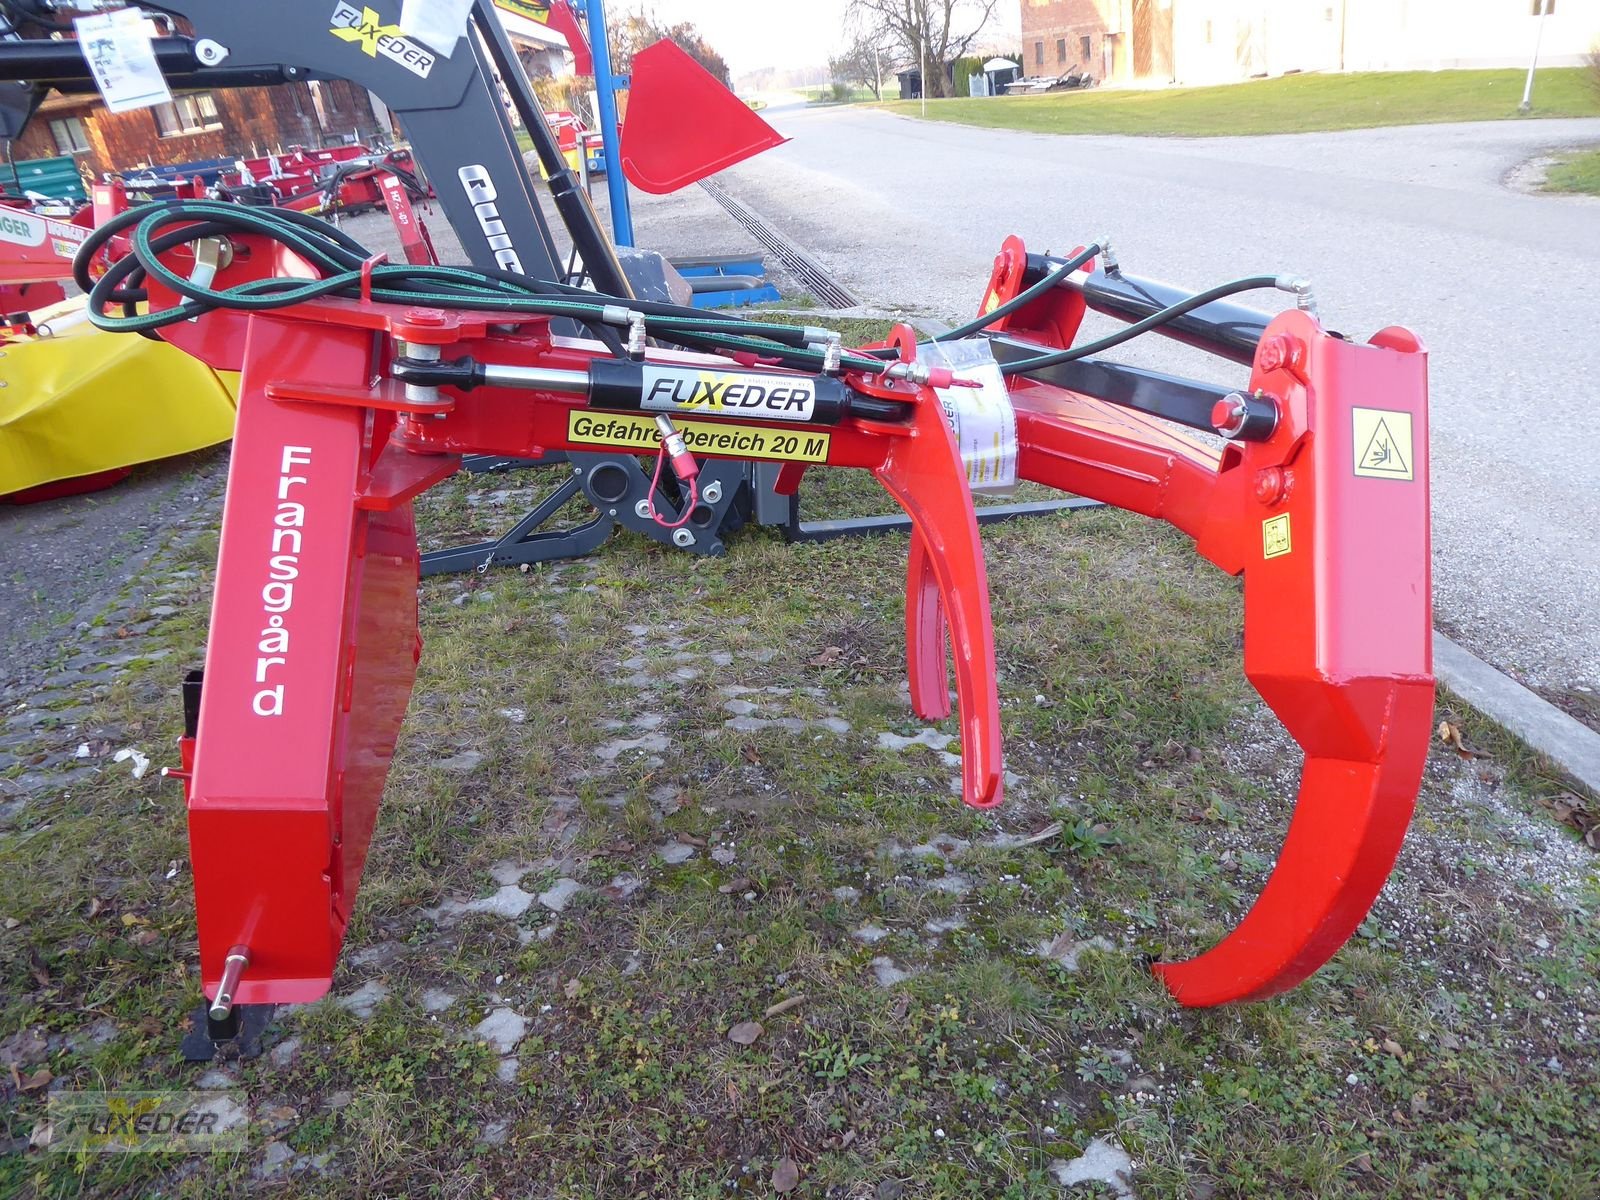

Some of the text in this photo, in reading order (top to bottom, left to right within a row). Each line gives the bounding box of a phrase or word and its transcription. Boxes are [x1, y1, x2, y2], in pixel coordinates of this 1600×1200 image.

[334, 9, 432, 70] FLIXEDER
[647, 378, 811, 411] FLIXEDER
[573, 418, 824, 457] Gefahrebereich 20 M
[252, 445, 312, 716] Fransgård
